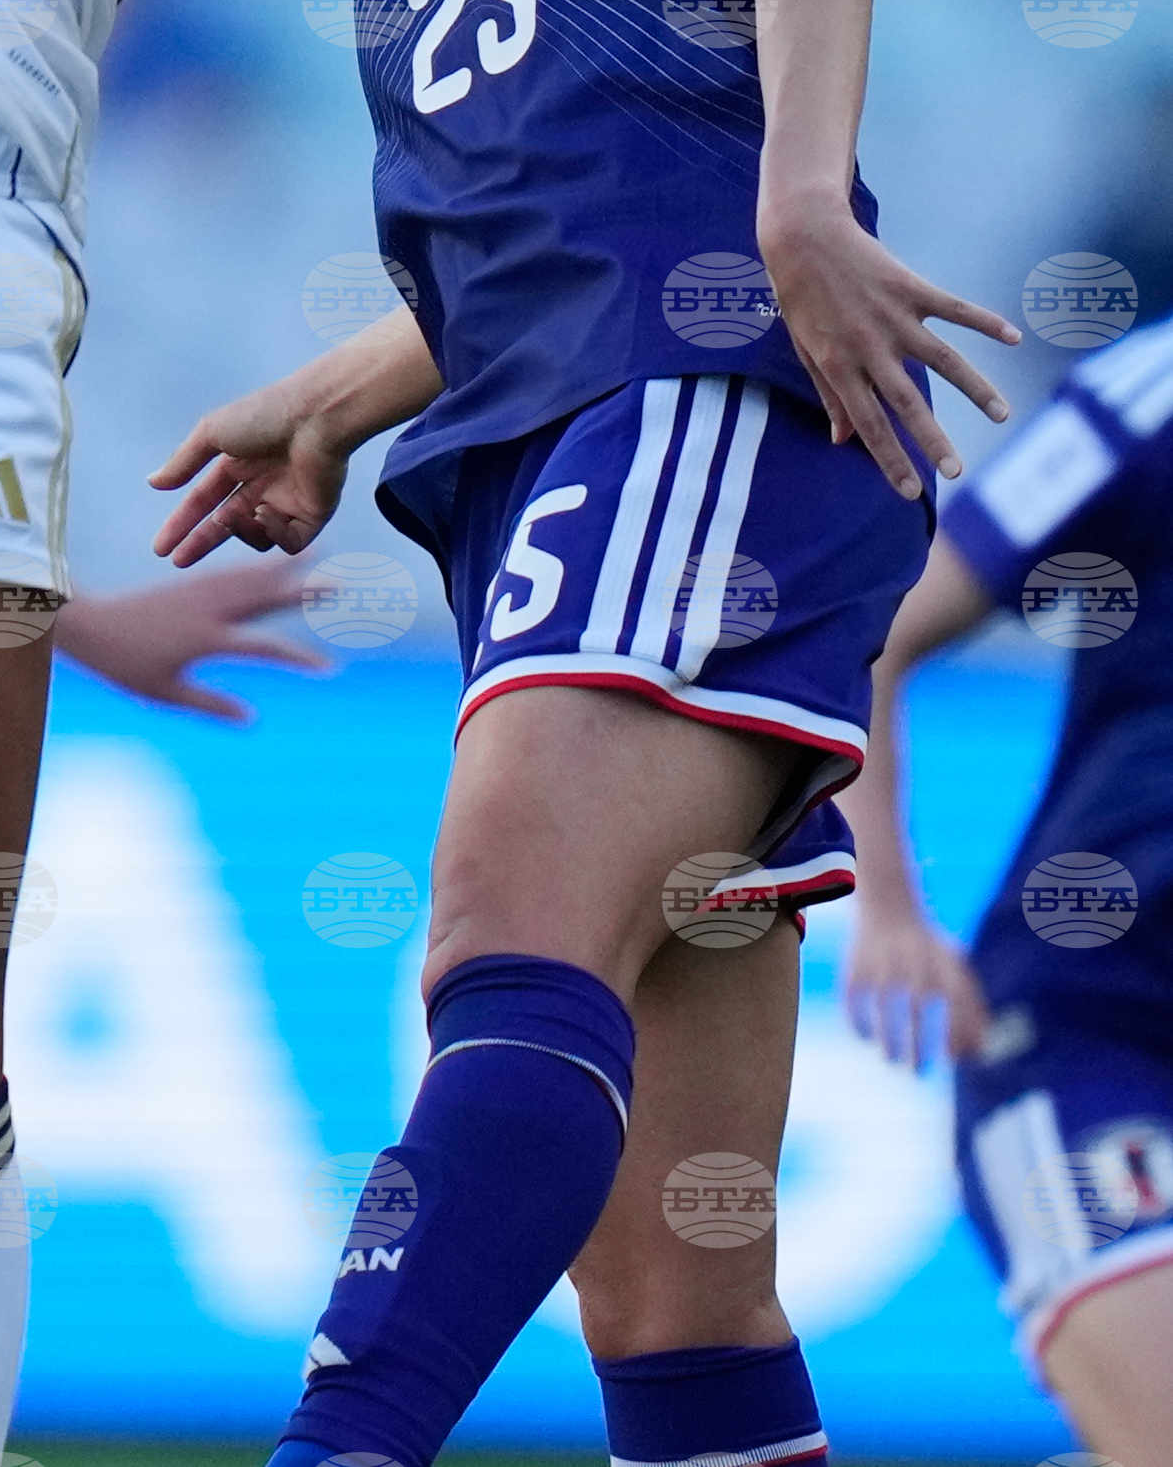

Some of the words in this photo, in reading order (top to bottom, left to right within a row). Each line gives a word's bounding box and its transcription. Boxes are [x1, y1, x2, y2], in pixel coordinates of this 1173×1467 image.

[759, 306, 783, 317] CLI
[472, 484, 588, 675] 5
[336, 1246, 405, 1279] AN
